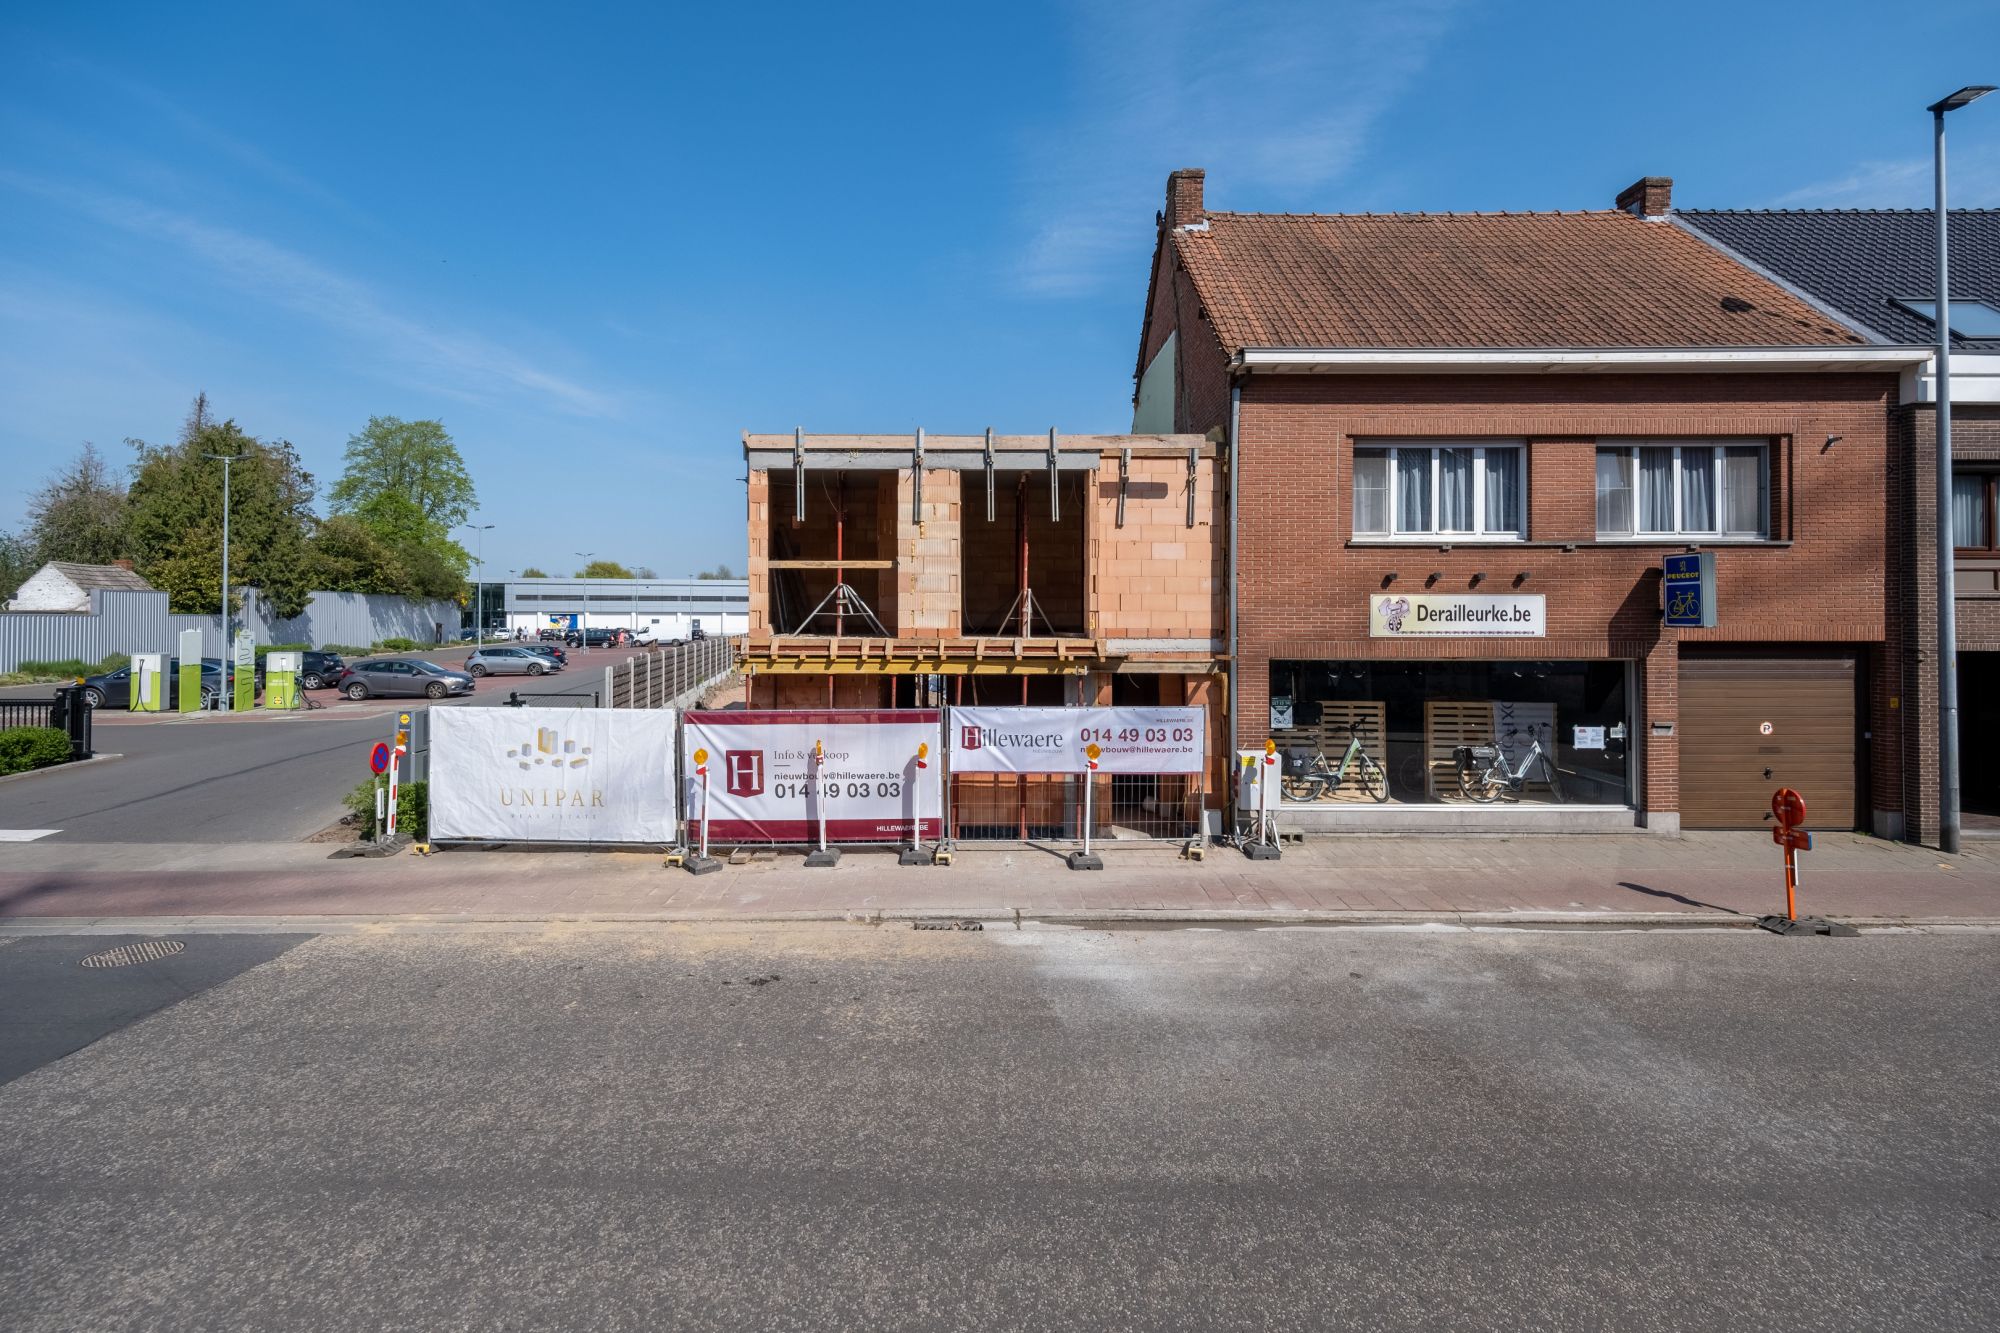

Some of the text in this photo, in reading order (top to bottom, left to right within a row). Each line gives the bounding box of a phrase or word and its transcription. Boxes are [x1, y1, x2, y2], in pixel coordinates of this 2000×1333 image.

[1417, 604, 1531, 622] Derailleurke.be
[963, 727, 1063, 748] Hillewaere
[1080, 728, 1194, 742] 014 49 03 03
[774, 750, 849, 761] Info & vekoop
[730, 755, 761, 790] H
[500, 788, 605, 808] UNIPAR
[775, 783, 810, 799] 014
[847, 783, 870, 798] 03
[877, 783, 900, 798] 03
